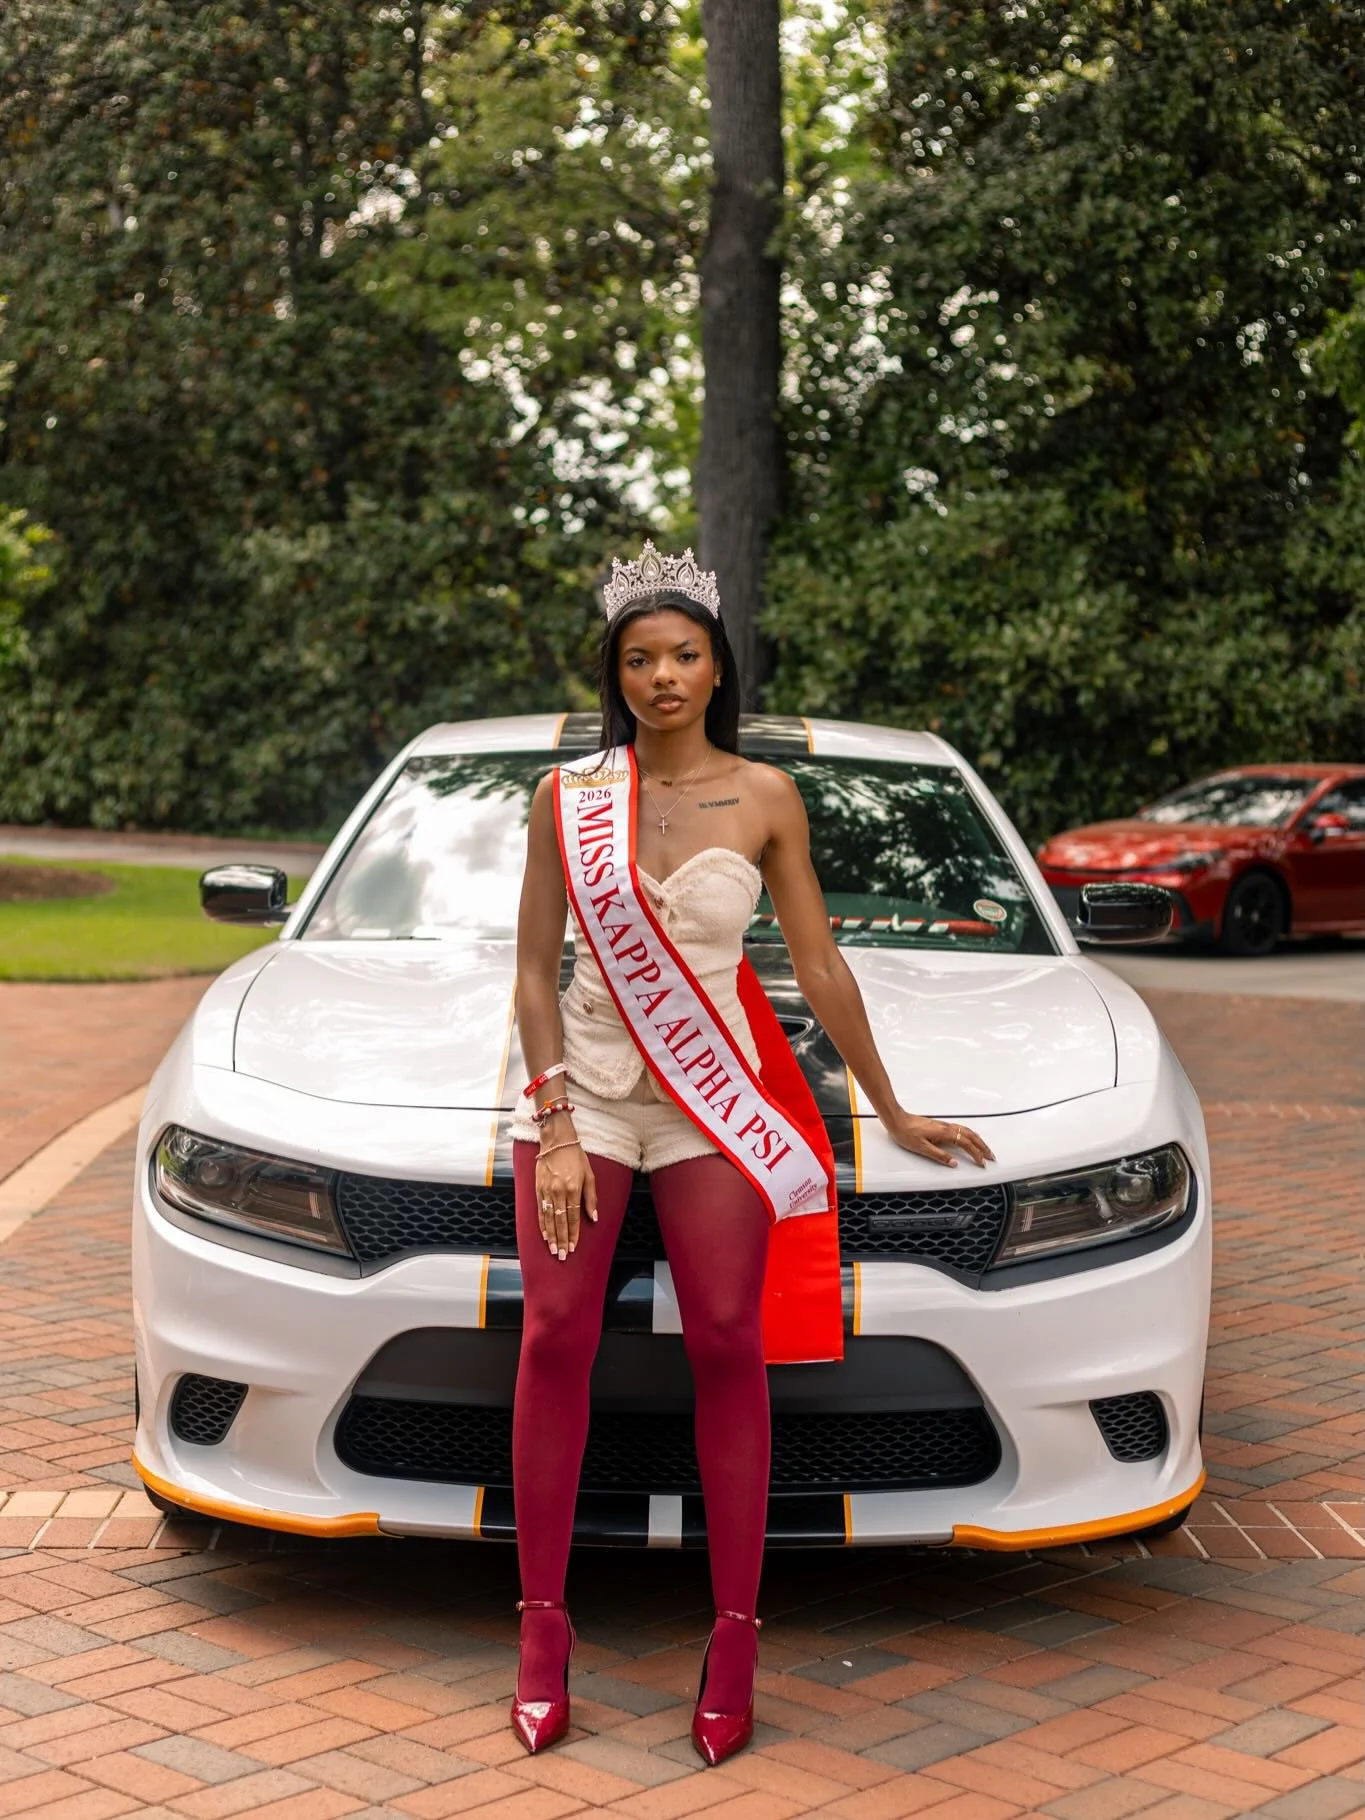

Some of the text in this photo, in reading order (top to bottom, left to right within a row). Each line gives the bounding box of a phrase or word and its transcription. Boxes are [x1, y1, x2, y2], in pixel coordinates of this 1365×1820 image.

[579, 788, 612, 803] 2026
[577, 799, 794, 1174] MISS KAPPA ALPHA PSI
[789, 1177, 812, 1200] Clemson
[789, 1183, 818, 1209] University
